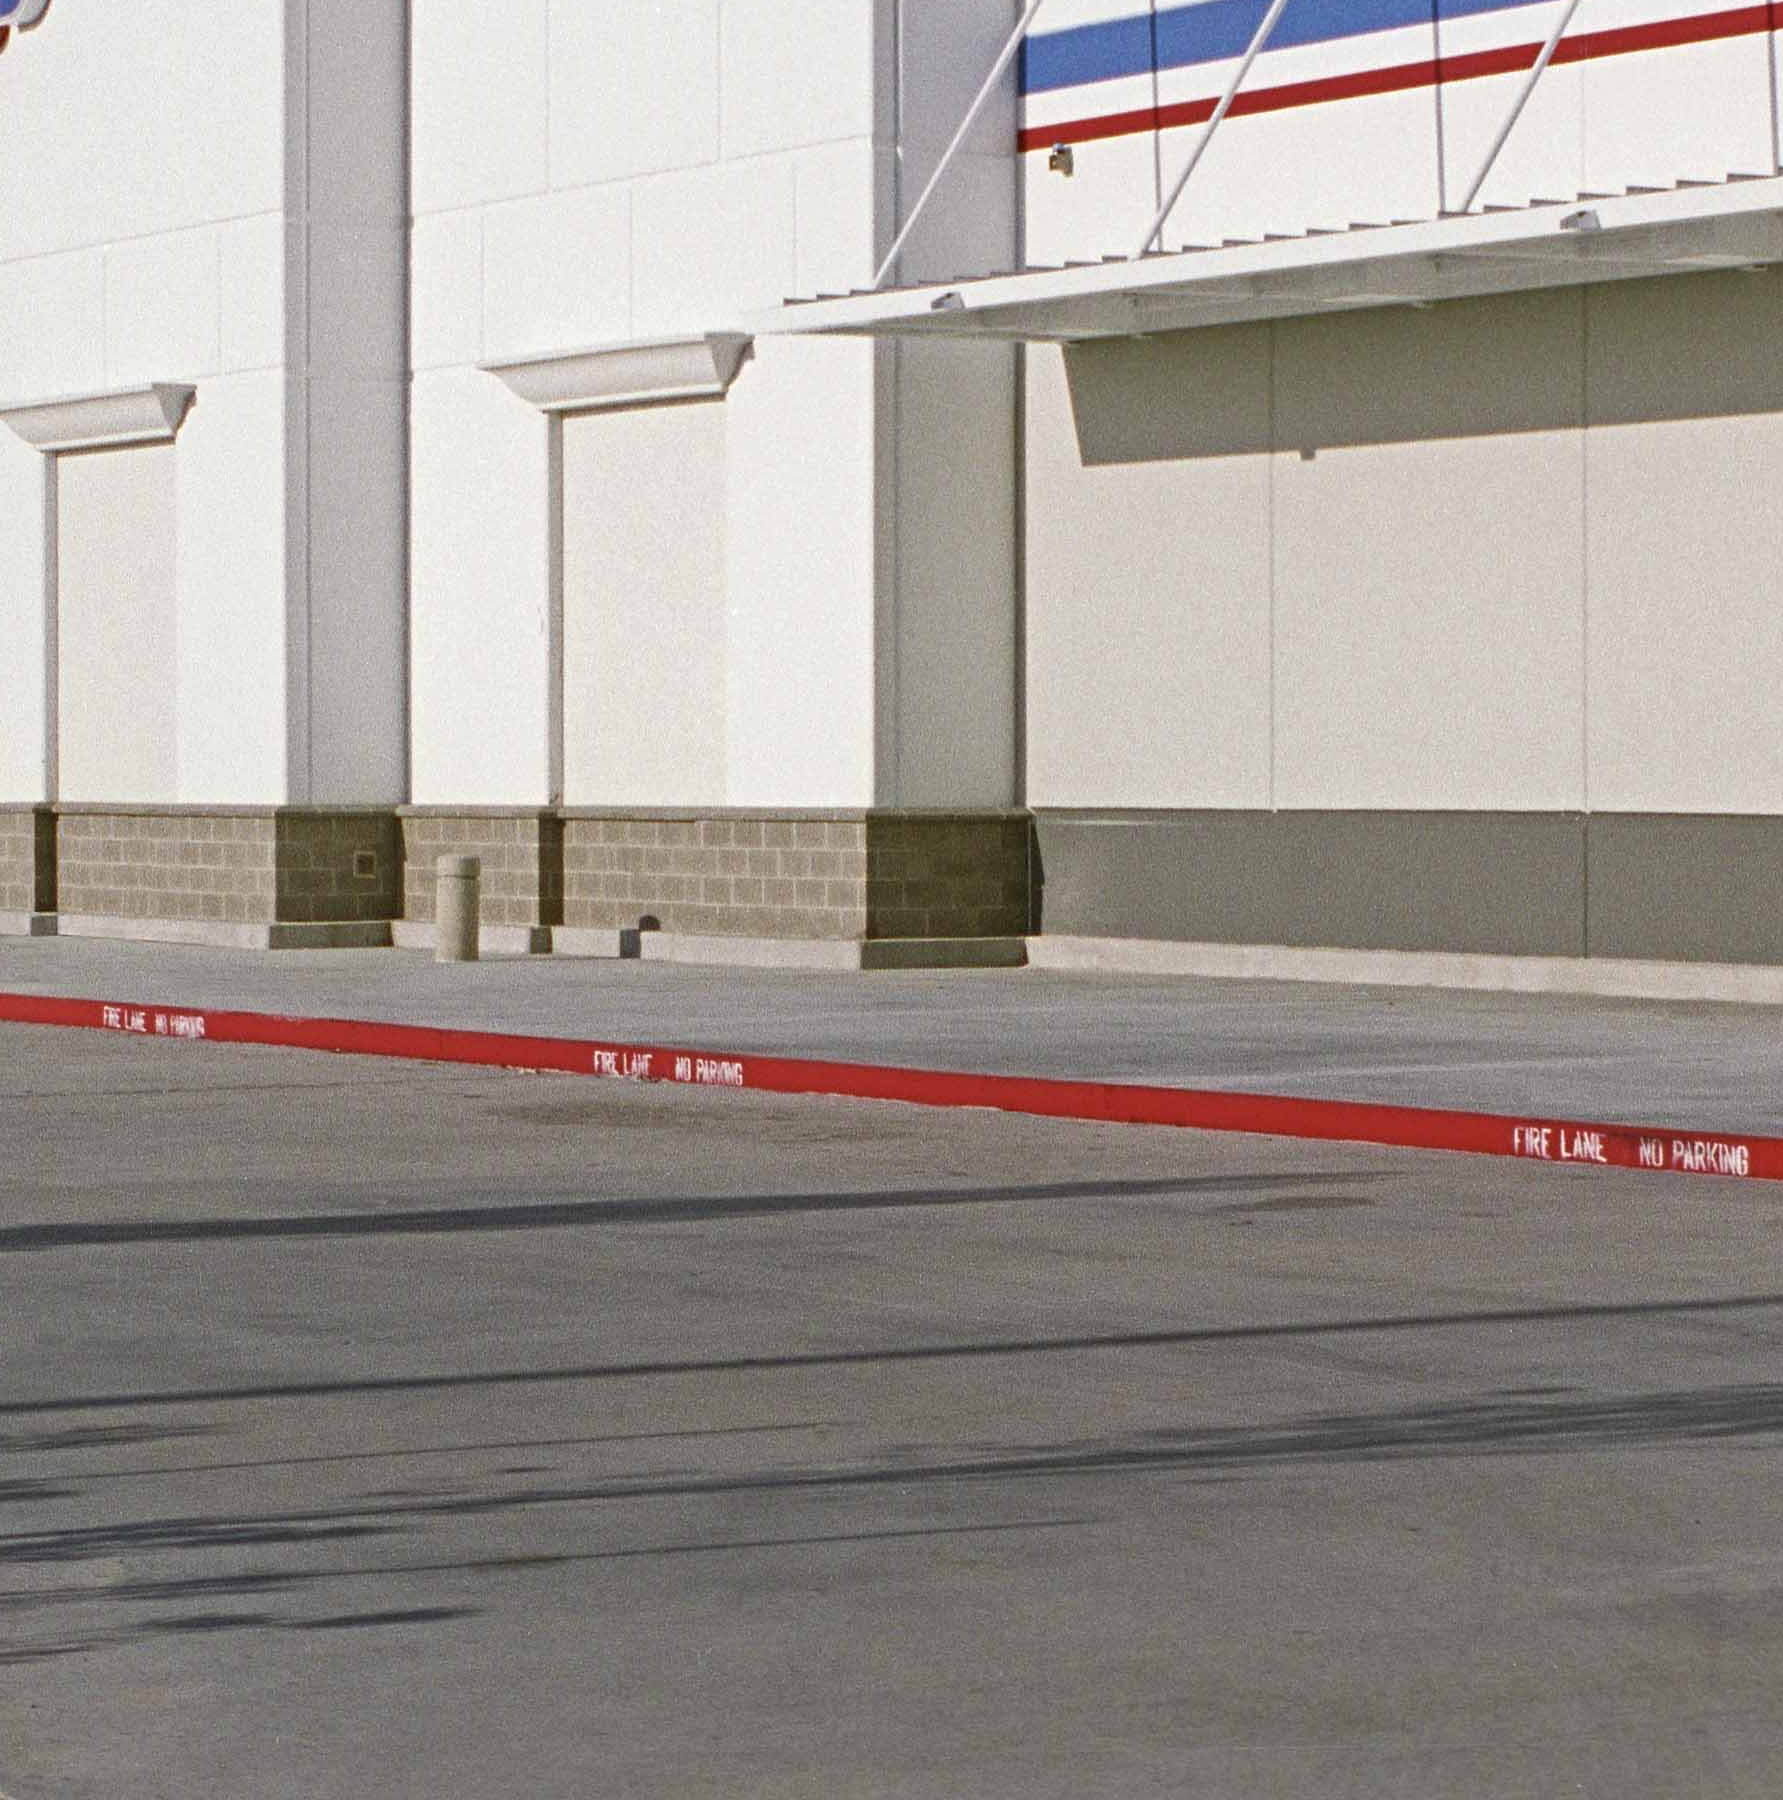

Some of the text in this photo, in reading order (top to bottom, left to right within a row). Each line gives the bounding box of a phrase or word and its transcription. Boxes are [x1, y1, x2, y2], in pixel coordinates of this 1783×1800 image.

[593, 1050, 623, 1076] FIRE
[674, 1056, 692, 1081] NO
[695, 1058, 744, 1086] PARKING
[1513, 1126, 1749, 1176] FIRE LANE NO PARKING
